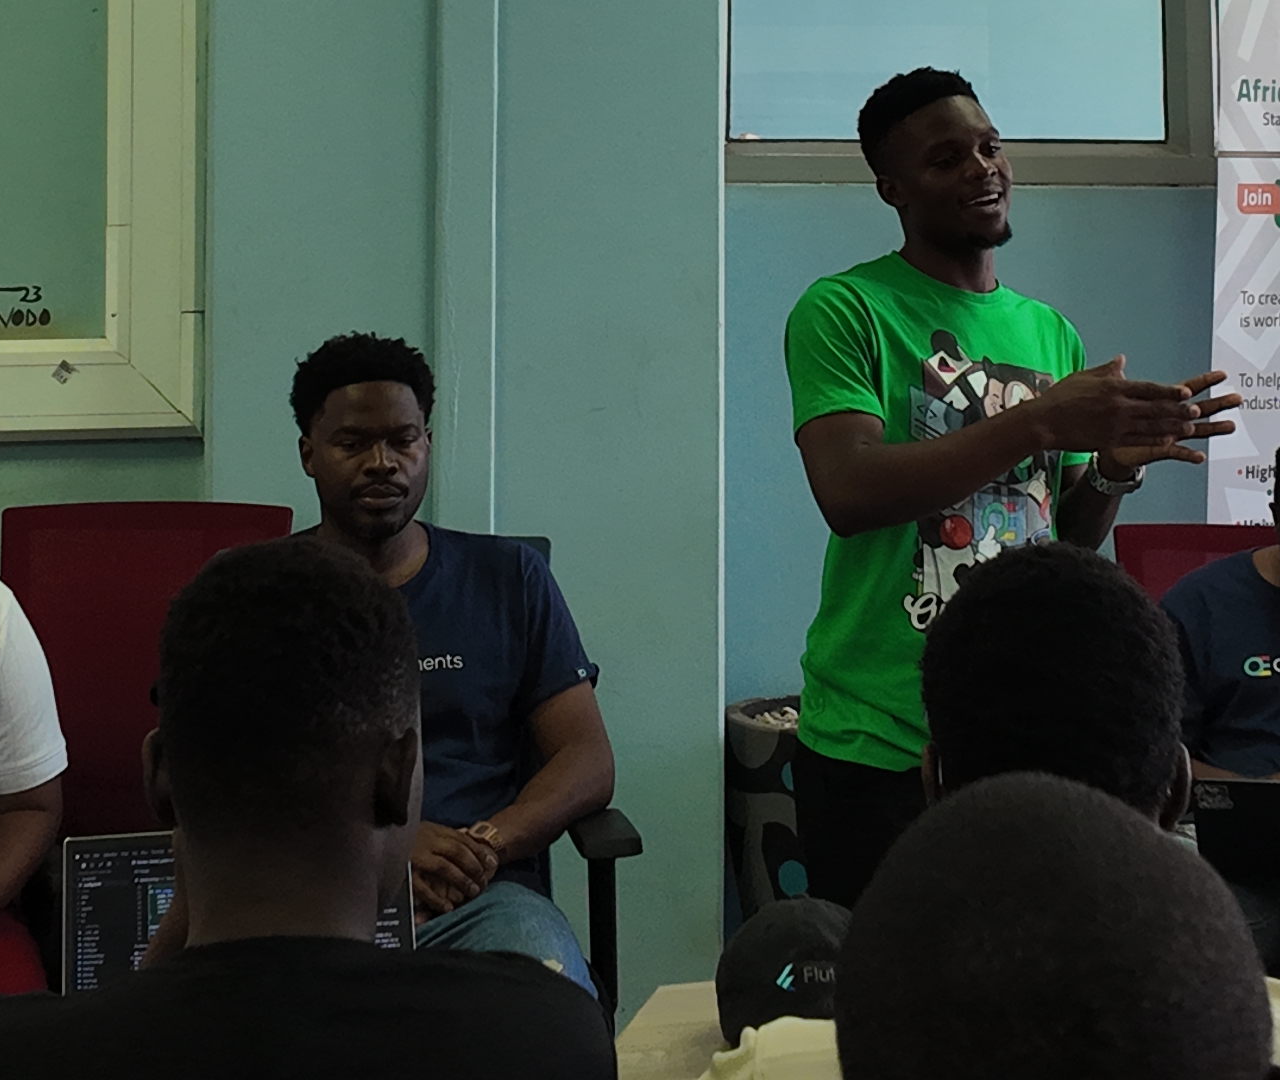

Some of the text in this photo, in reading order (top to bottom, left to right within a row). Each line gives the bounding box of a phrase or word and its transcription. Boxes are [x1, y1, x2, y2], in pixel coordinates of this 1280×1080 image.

[1243, 188, 1272, 207] Join
[1241, 291, 1255, 305] To
[1239, 313, 1251, 328] is
[1239, 373, 1253, 388] To
[803, 966, 836, 984] Flut
